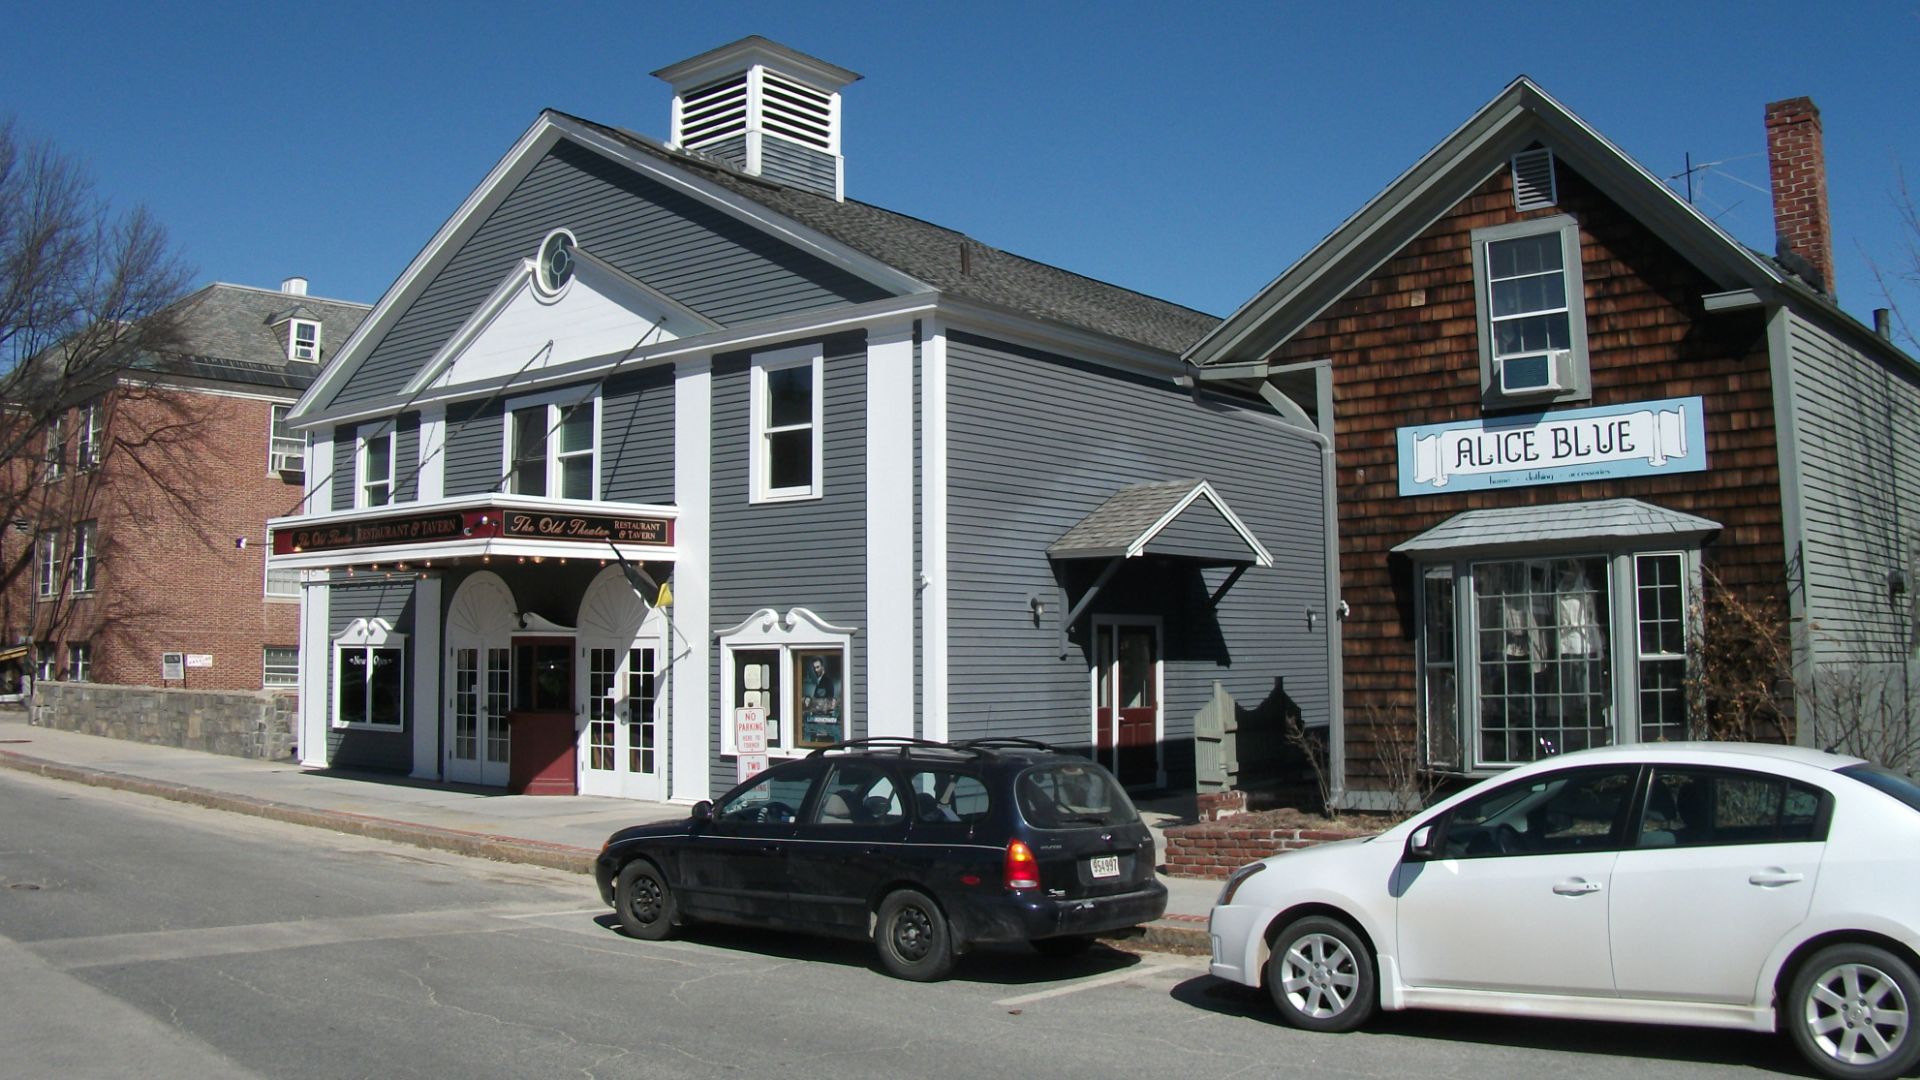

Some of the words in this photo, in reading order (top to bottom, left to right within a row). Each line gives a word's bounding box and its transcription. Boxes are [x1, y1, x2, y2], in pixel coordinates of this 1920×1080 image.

[1455, 430, 1540, 468] ALICE
[1551, 420, 1635, 459] BLUE
[1525, 471, 1554, 481] clothing
[357, 523, 409, 540] RESTAURANT
[411, 521, 419, 537] &
[422, 519, 456, 535] TAVERN
[510, 515, 534, 533] The
[539, 517, 566, 534] Old
[567, 518, 610, 537] Theater
[614, 520, 660, 531] RESTAURANT
[618, 531, 626, 539] &
[628, 530, 656, 540] TAVERN
[745, 712, 756, 721] NO
[738, 723, 763, 731] PARKING
[747, 762, 760, 770] TWO
